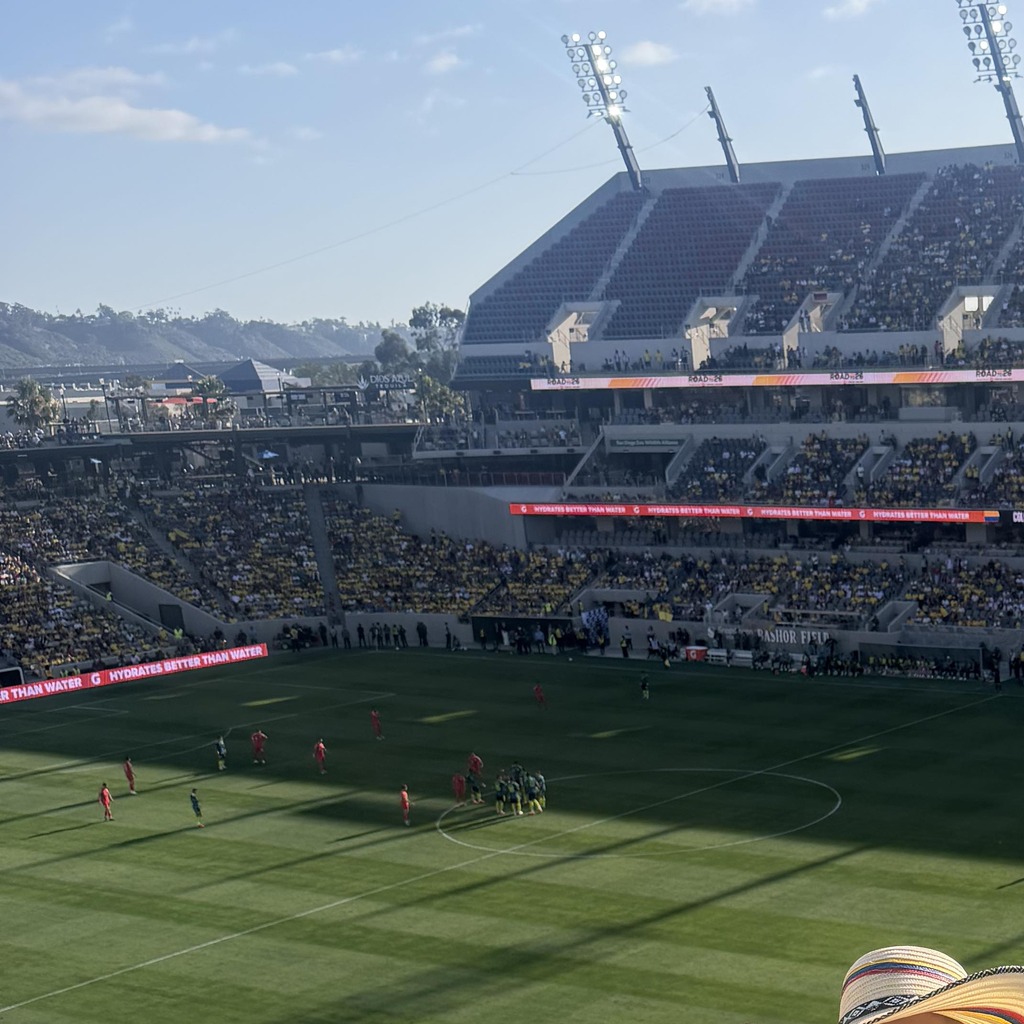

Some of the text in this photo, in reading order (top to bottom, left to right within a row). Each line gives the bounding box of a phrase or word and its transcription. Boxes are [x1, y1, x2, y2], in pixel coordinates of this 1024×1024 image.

[91, 647, 263, 685] G HYDRATES BETTER THAN WATER
[11, 684, 42, 699] THAN
[44, 678, 82, 693] WATER
